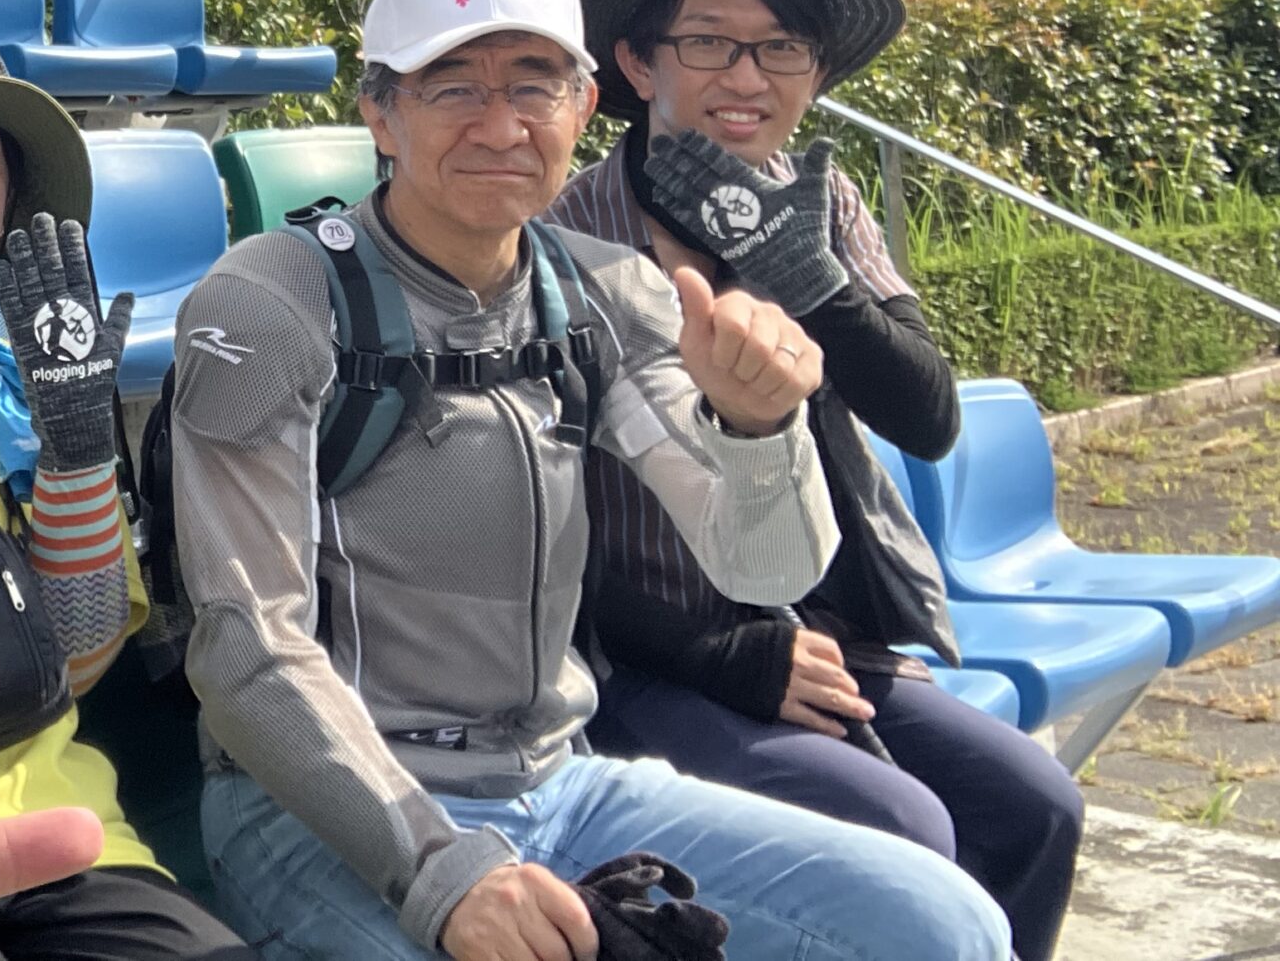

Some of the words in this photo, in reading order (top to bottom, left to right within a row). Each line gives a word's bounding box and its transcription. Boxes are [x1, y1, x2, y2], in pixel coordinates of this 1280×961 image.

[327, 225, 345, 239] 70
[763, 205, 795, 238] Japan
[32, 363, 86, 383] Plogging
[87, 358, 113, 377] Japan
